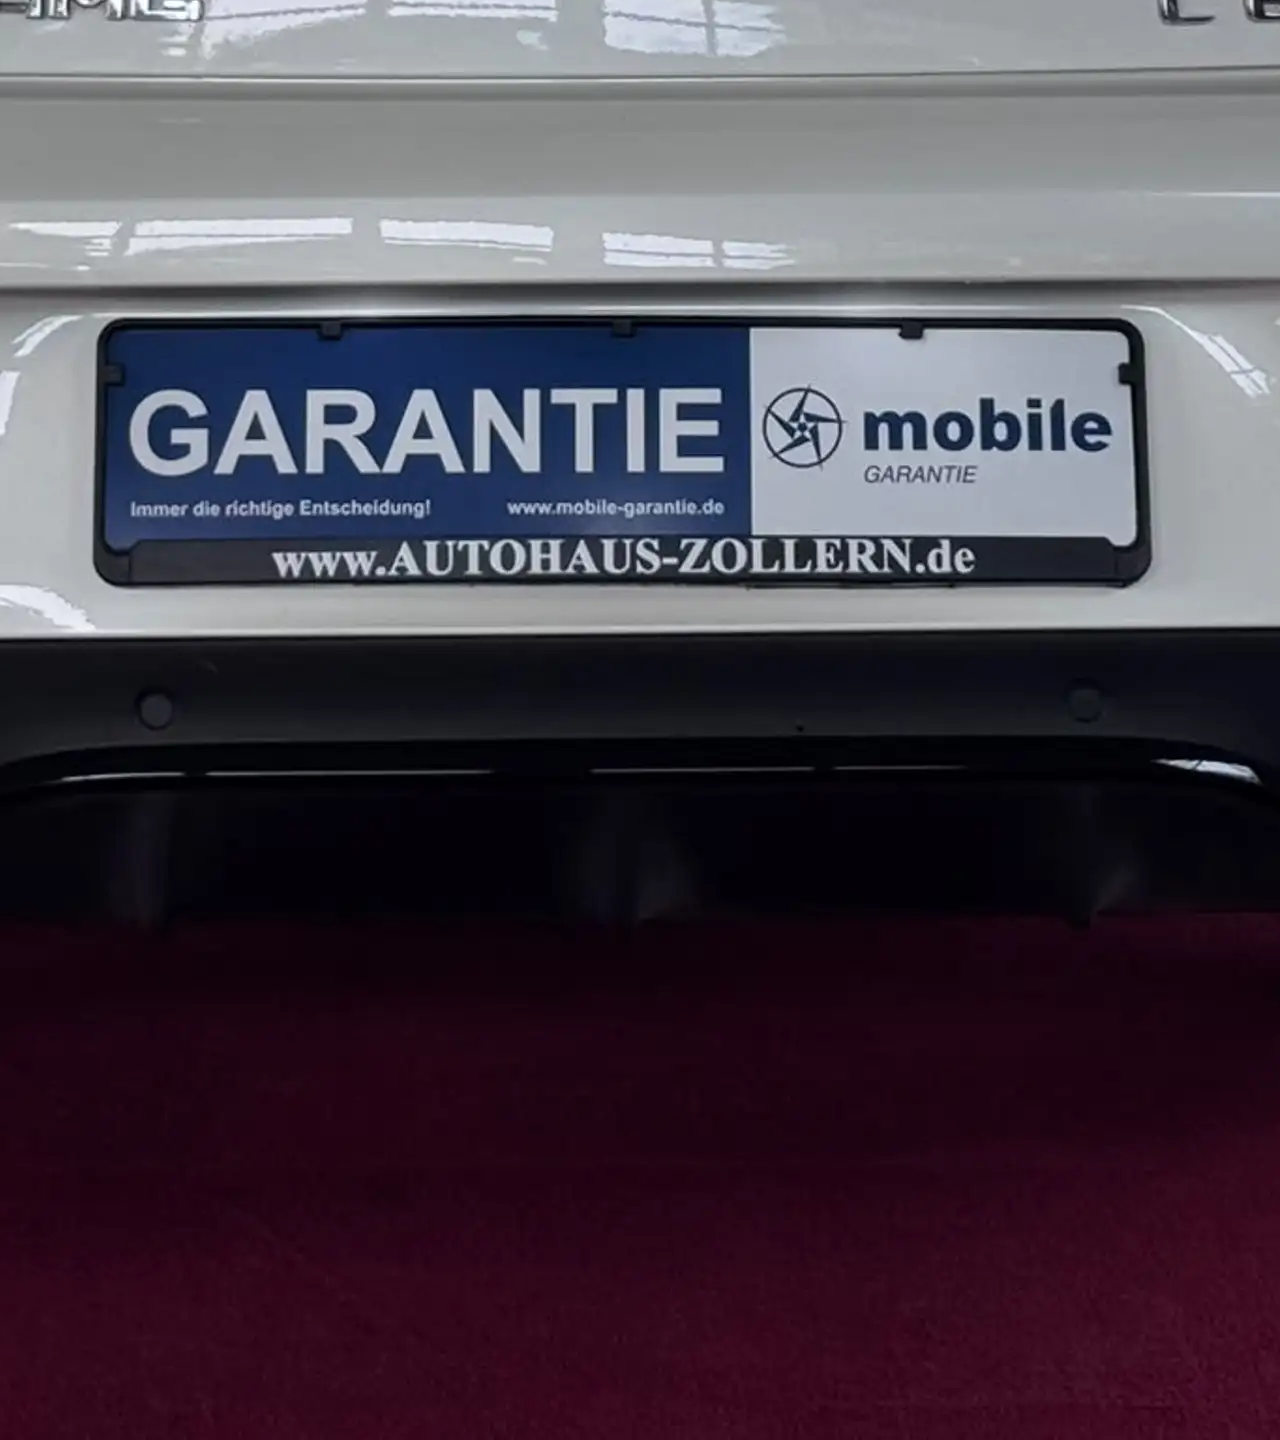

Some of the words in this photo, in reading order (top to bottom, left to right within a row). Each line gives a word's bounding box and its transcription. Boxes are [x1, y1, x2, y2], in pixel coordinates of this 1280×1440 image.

[128, 388, 724, 476] GARANTIE
[863, 397, 1113, 453] mobile
[864, 465, 978, 484] GARANTIE
[130, 501, 188, 517] Immer
[192, 500, 220, 517] die
[224, 500, 295, 520] richtige
[299, 499, 431, 519] Entscheidung!
[506, 498, 725, 518] www.mobile-garantie.de
[271, 538, 976, 578] www.AUTOHAUS-ZOLLERN.de
